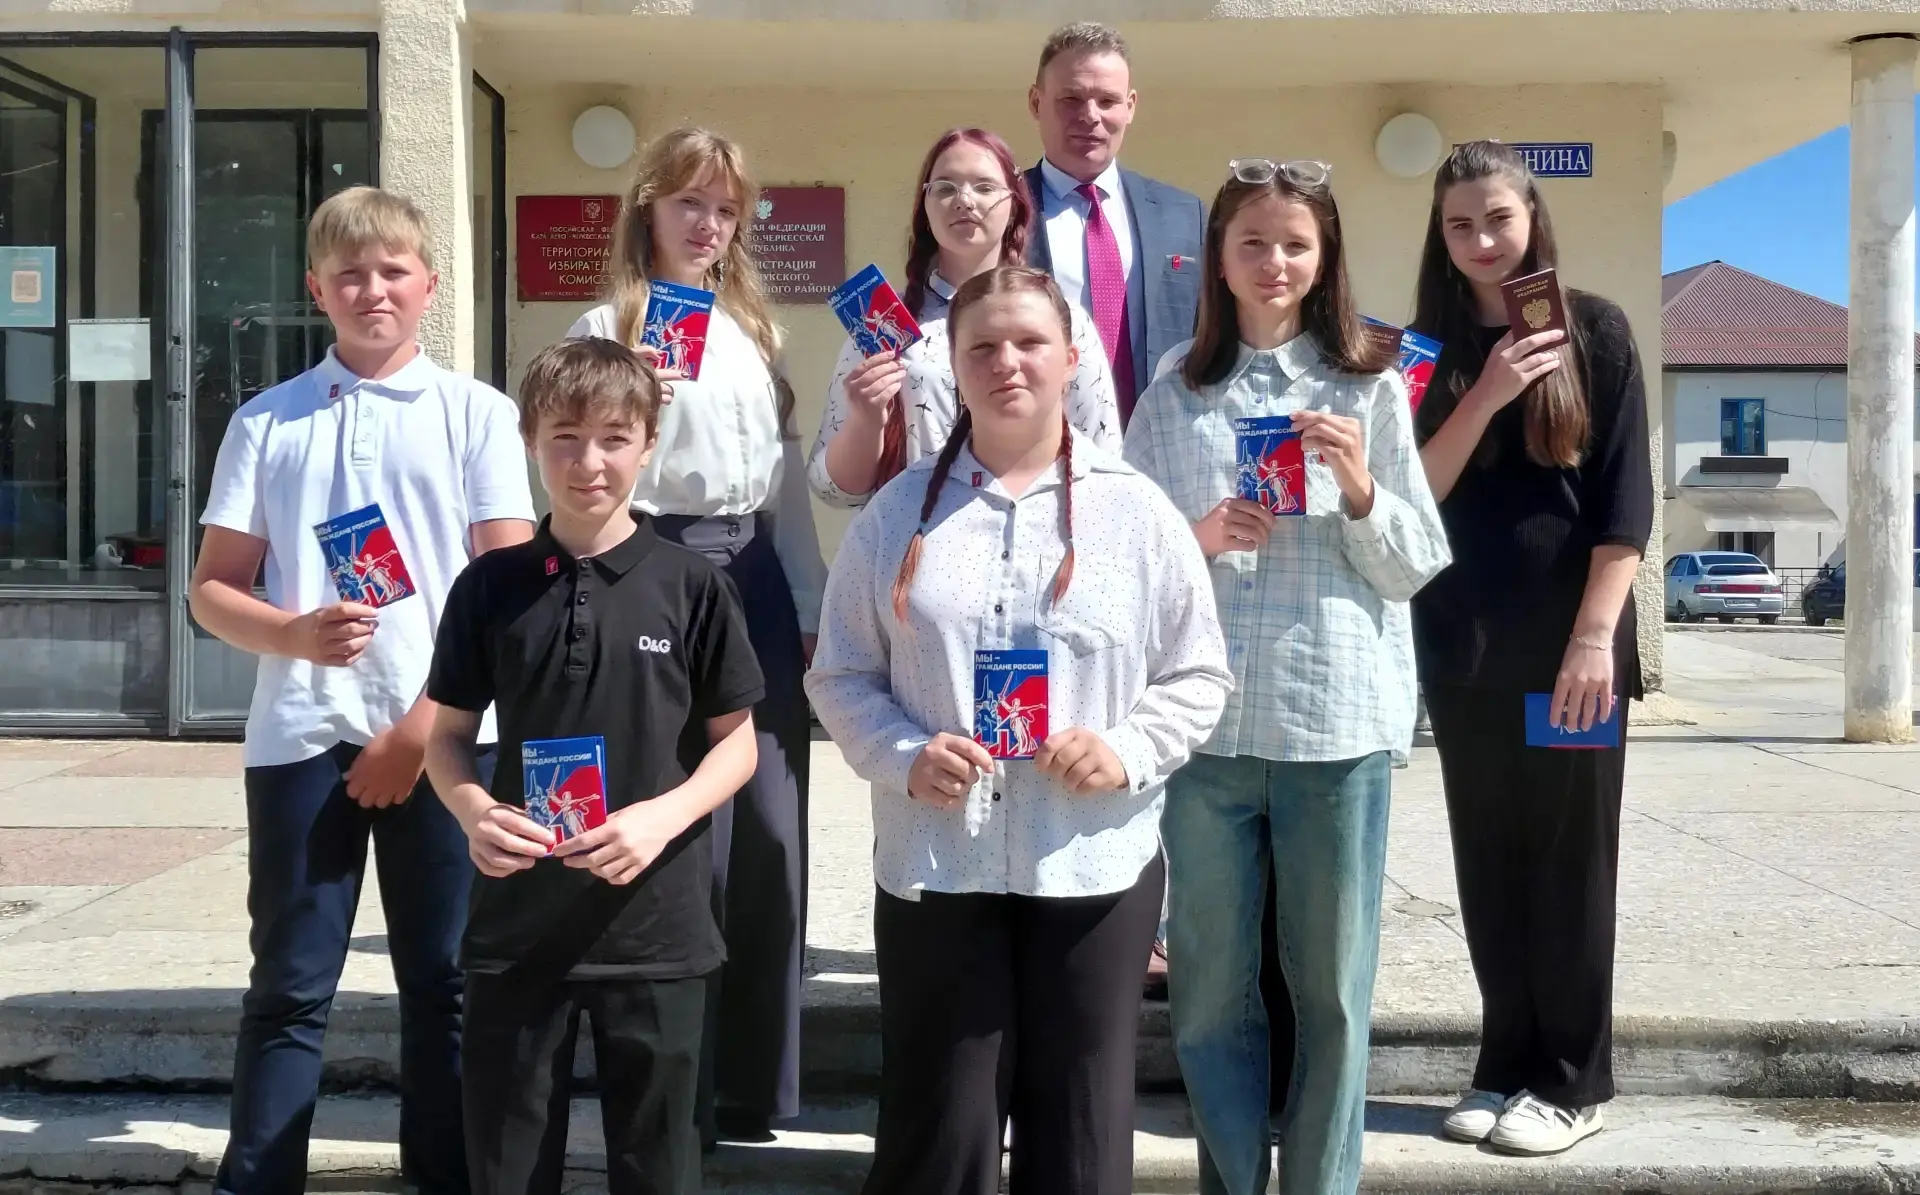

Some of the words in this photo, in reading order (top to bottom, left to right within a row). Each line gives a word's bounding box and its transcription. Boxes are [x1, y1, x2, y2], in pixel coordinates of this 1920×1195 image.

[746, 224, 764, 232] КАЯ
[768, 223, 826, 233] ФЕДЕРАЦИЯ
[746, 234, 825, 242] ВО-ЧЕРКЕССКАЯ
[541, 246, 610, 257] ТЕРРИТОРИА
[750, 244, 795, 253] ПУБЛИКА
[549, 260, 611, 271] ИЗБИРАТЕЛ
[755, 260, 816, 270] ИСТРАЦИЯ
[559, 274, 611, 285] КОМИСС
[760, 273, 810, 281] УКСКОГО
[794, 283, 837, 293] РАЙОНА
[1235, 421, 1250, 430] МЫ
[638, 635, 672, 654] D&G
[975, 654, 992, 662] МЫ
[975, 663, 1012, 671] ГРАЖДАНЕ
